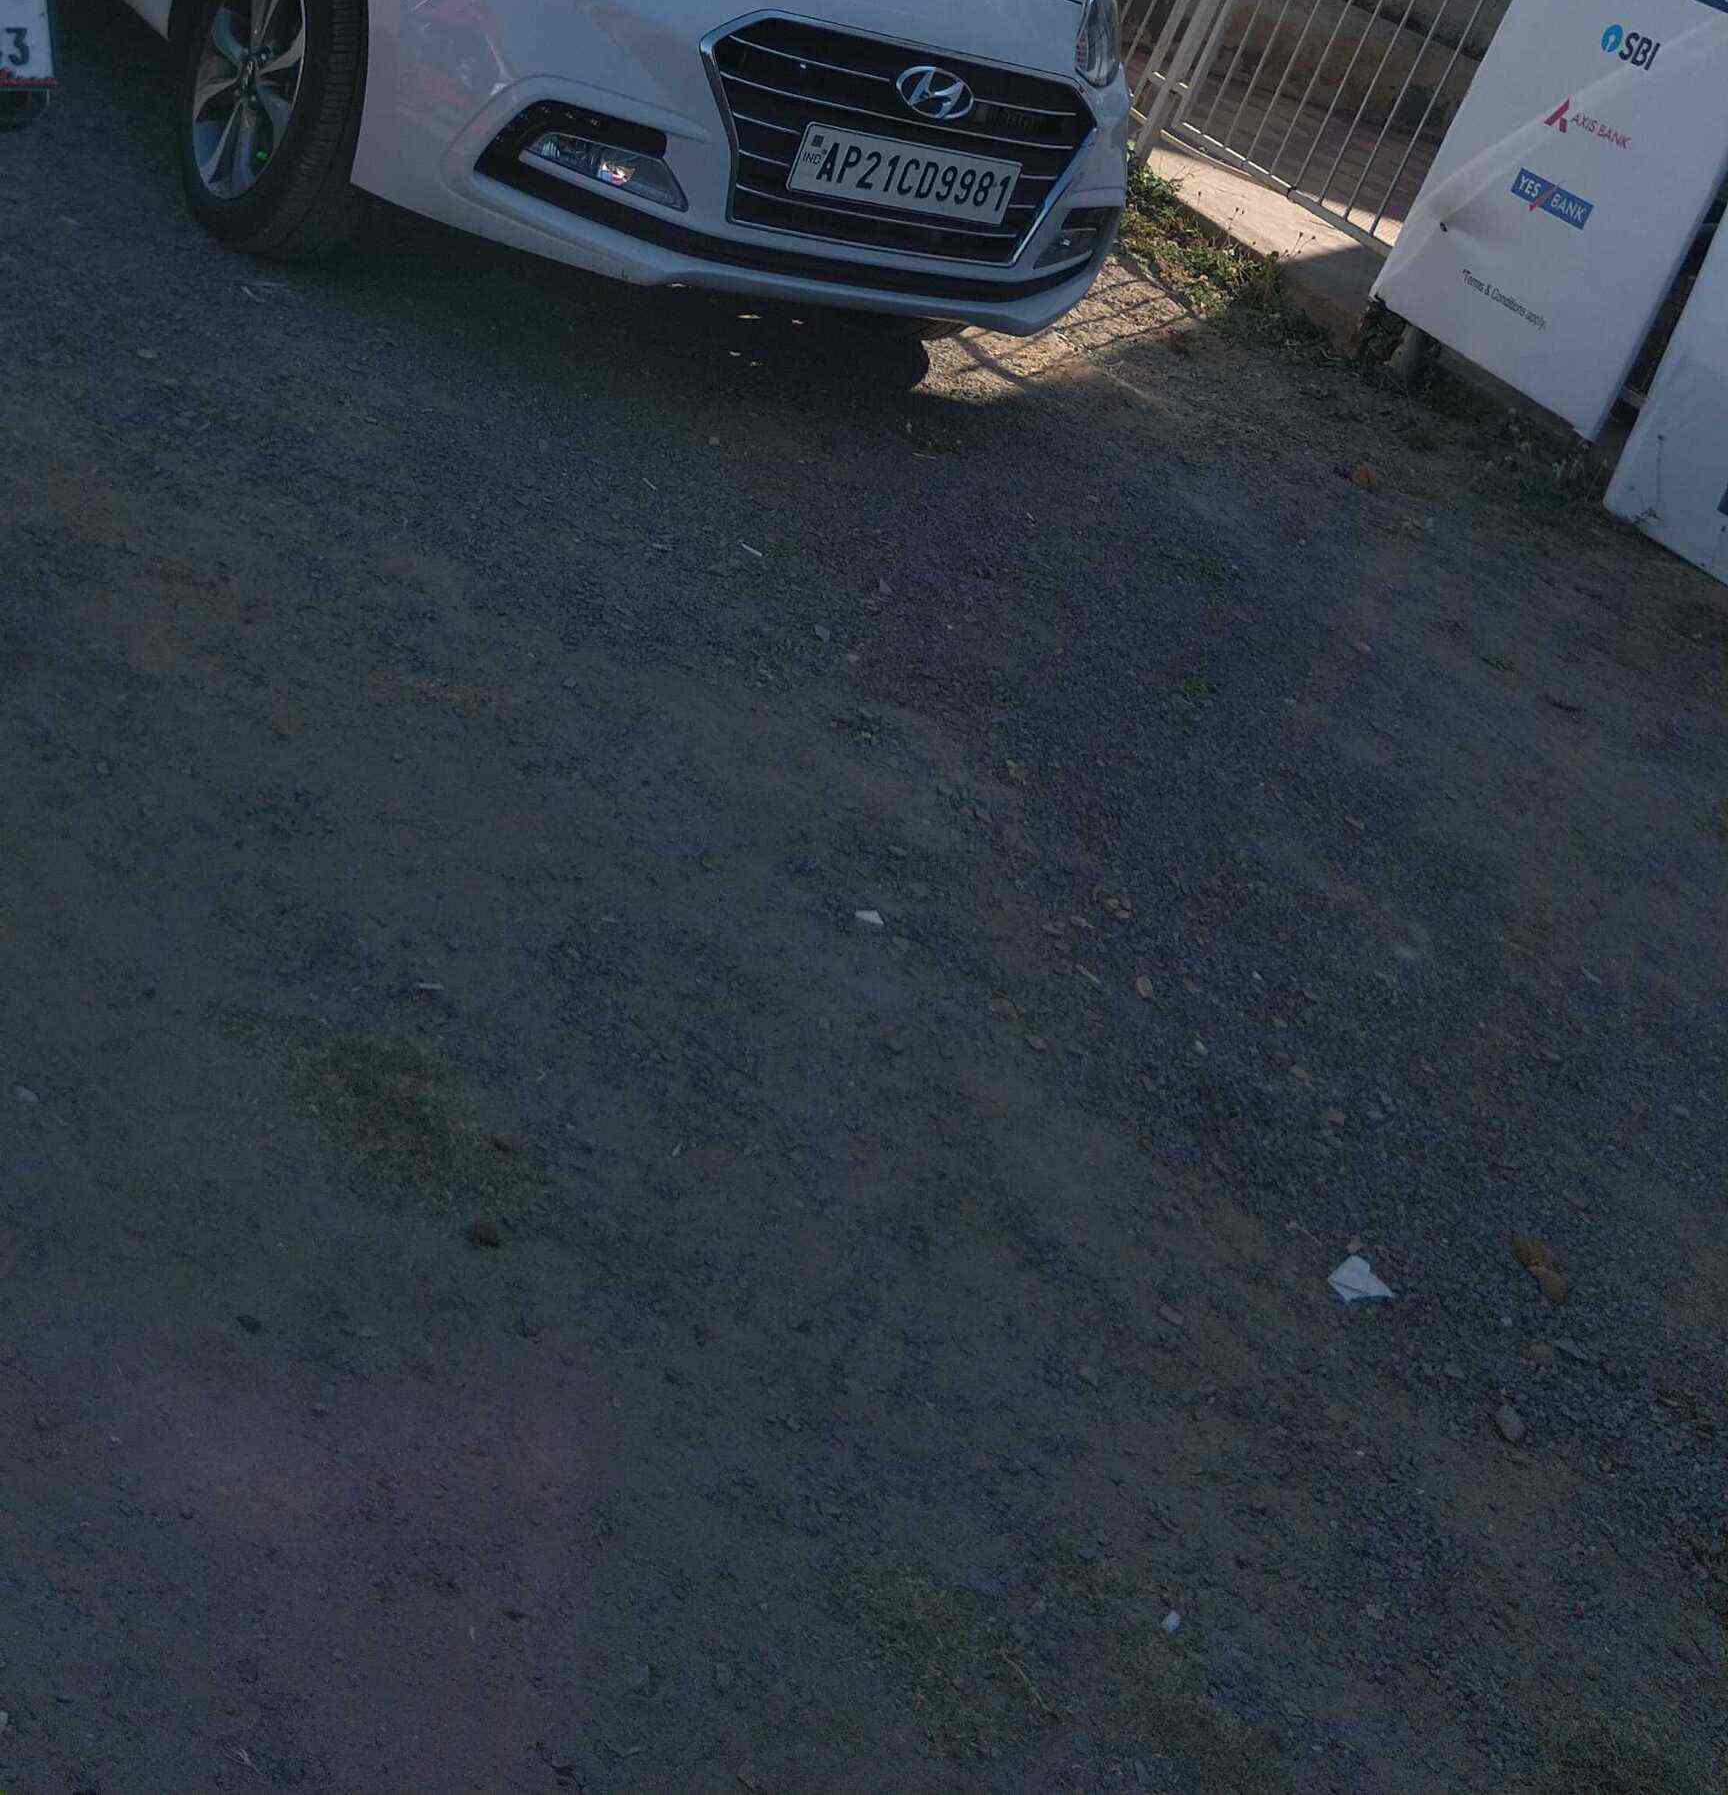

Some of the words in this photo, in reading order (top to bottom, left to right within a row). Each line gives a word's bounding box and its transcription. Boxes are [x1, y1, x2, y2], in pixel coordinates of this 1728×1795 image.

[0, 27, 30, 67] 3
[1619, 32, 1661, 71] SBI
[1571, 113, 1596, 133] AXIS
[1597, 124, 1633, 150] BANK
[815, 142, 1012, 212] AP21CD9981
[1520, 174, 1542, 198] YES
[1550, 193, 1587, 223] BANK
